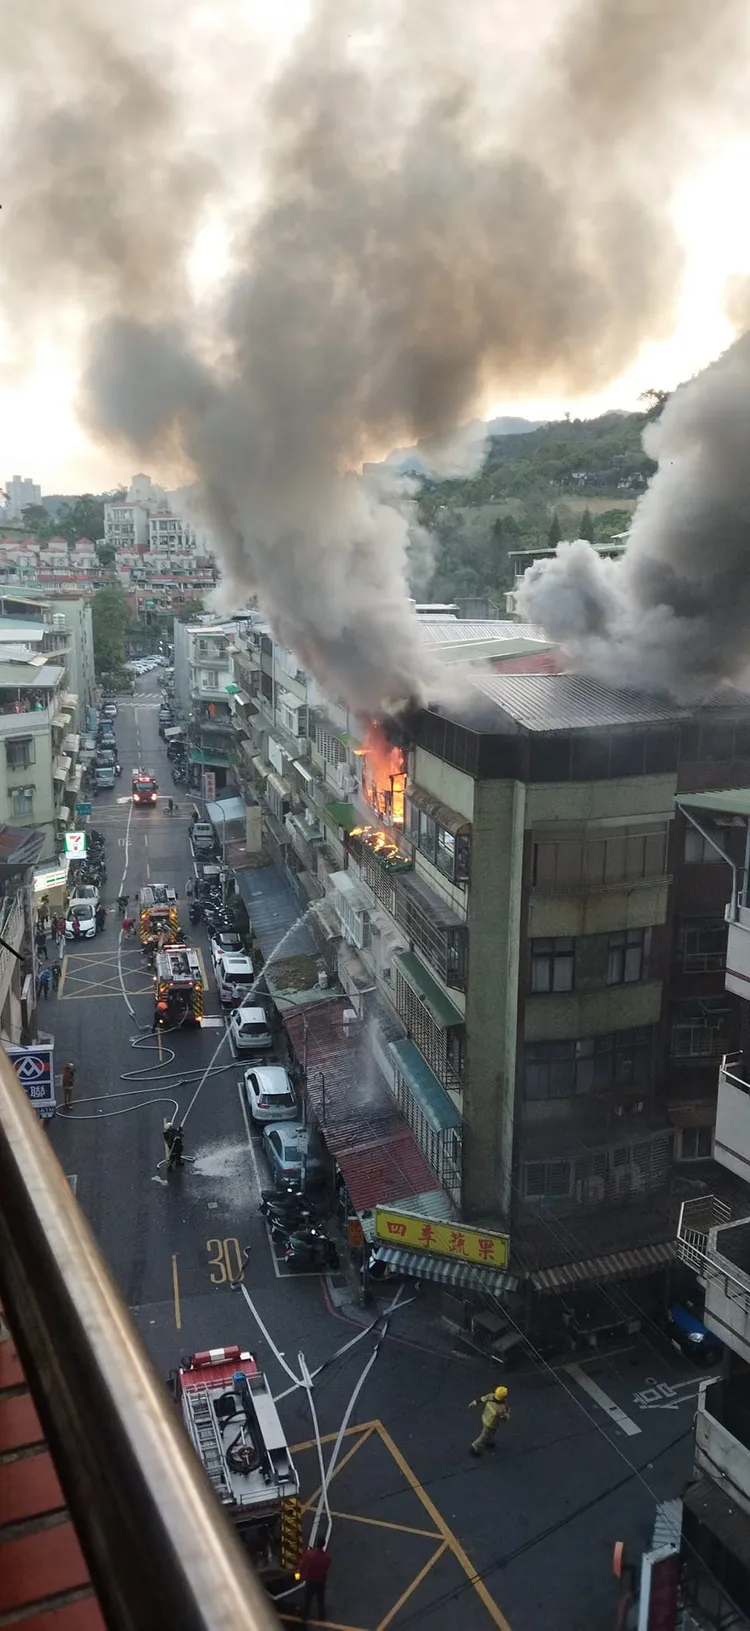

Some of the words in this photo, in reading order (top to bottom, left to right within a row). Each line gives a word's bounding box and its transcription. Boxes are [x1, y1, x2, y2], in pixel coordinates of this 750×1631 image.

[207, 1238, 244, 1284] 30
[386, 1221, 494, 1260] 四季蔬果
